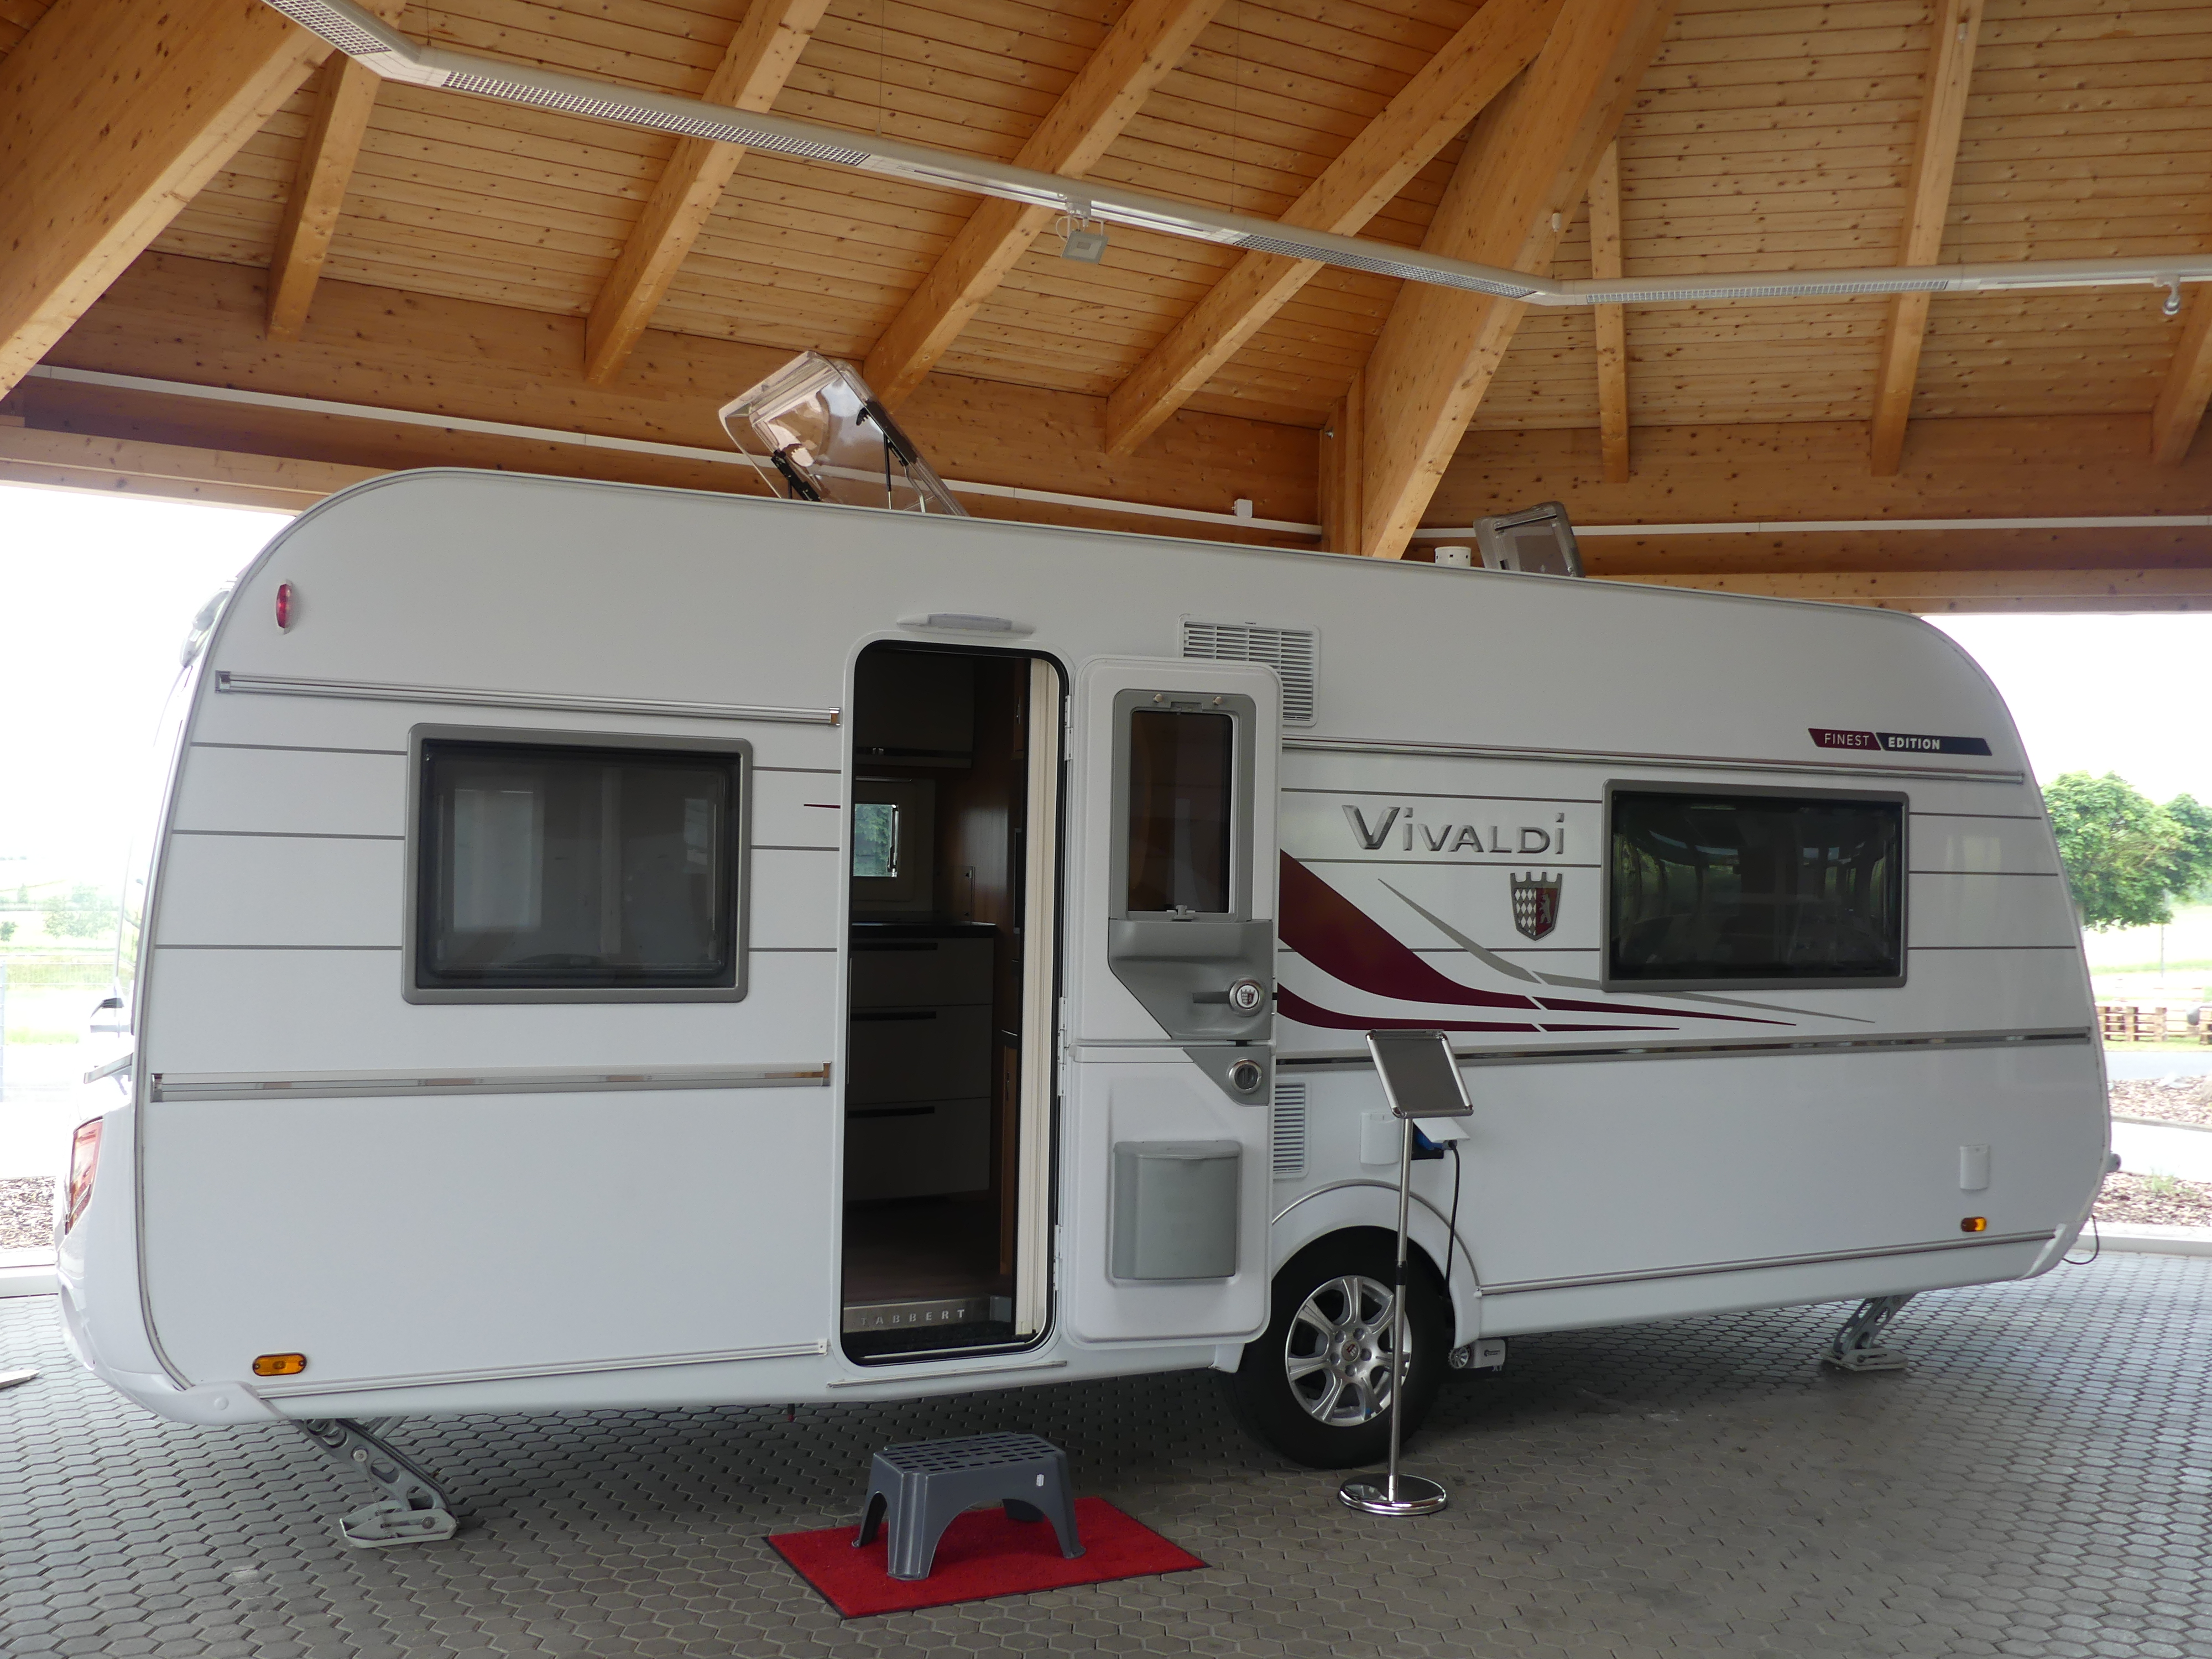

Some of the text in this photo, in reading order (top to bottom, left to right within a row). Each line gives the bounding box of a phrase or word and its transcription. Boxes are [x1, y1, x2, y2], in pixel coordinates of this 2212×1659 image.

[1824, 733, 1940, 750] FINEST EDITION
[860, 1309, 965, 1326] TABBERT
